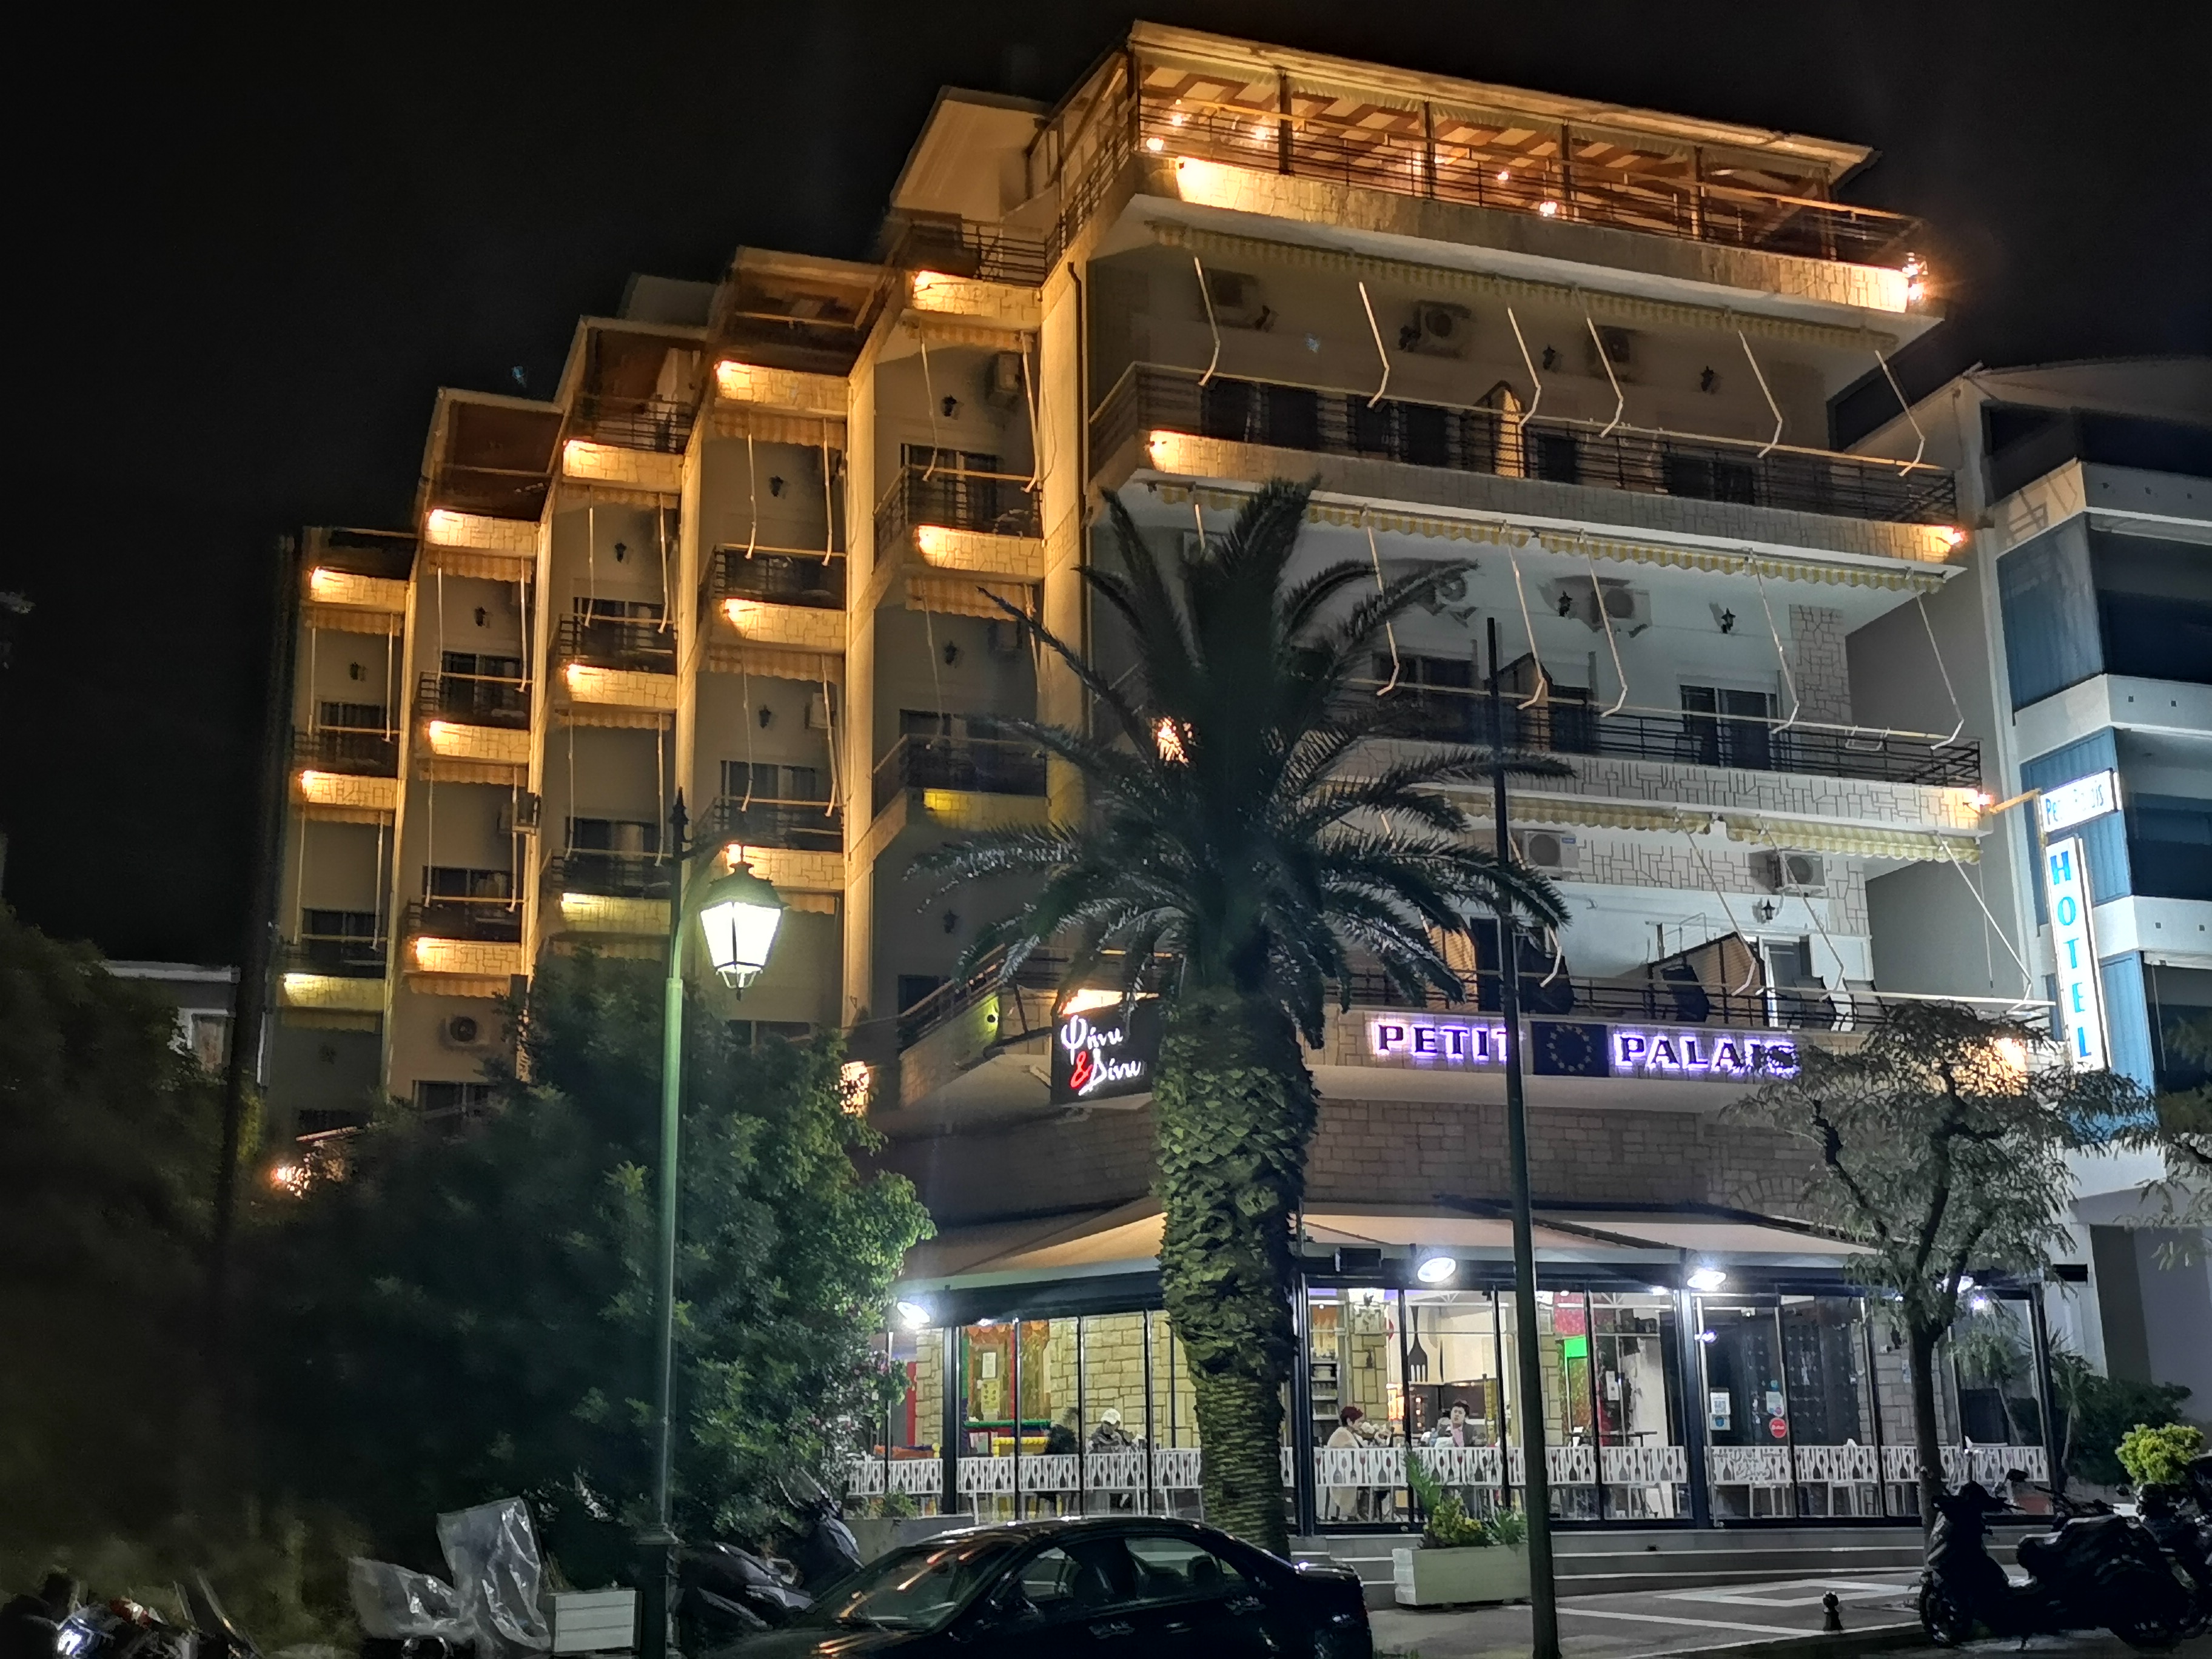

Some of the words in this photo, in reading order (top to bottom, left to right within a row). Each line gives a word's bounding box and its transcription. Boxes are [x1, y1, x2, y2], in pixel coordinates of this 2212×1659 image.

[2049, 850, 2092, 1057] HOTEL
[1070, 1050, 1093, 1088] &
[1617, 1034, 1798, 1074] PALAIS
